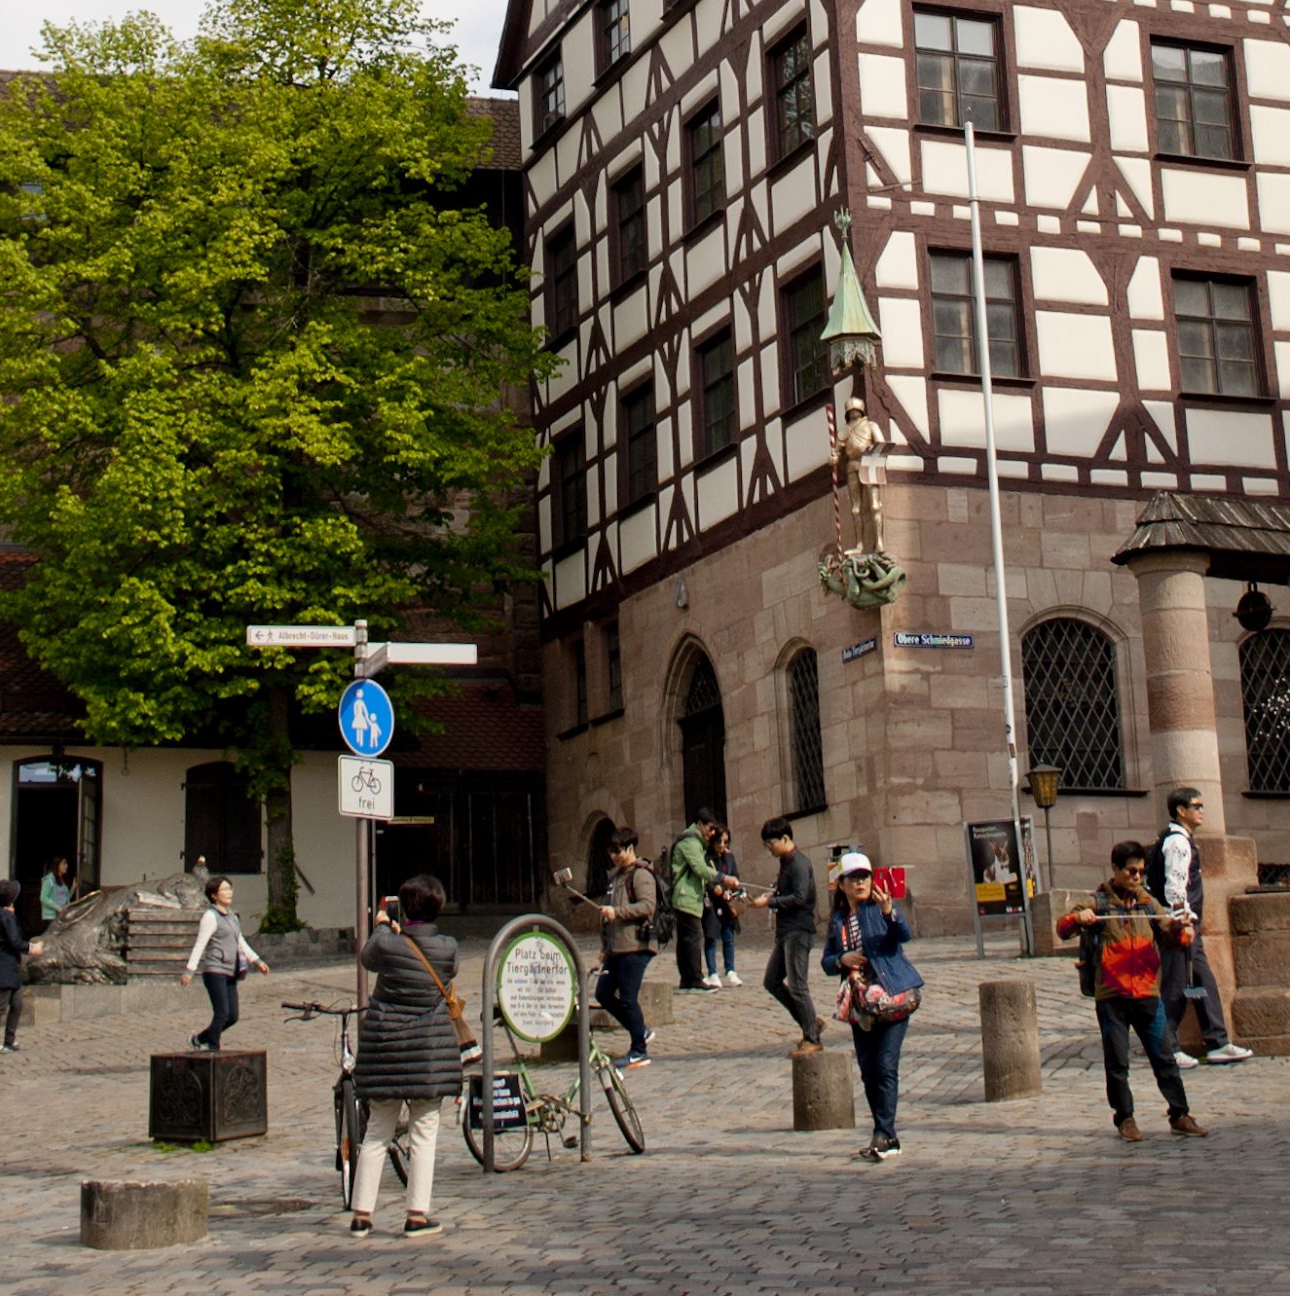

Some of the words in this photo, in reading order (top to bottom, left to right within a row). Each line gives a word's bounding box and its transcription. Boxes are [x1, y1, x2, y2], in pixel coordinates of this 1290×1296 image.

[278, 631, 349, 641] Albrecht-Dürer-Haus
[358, 796, 376, 810] frei
[515, 948, 537, 960] Platz
[539, 949, 562, 962] beim
